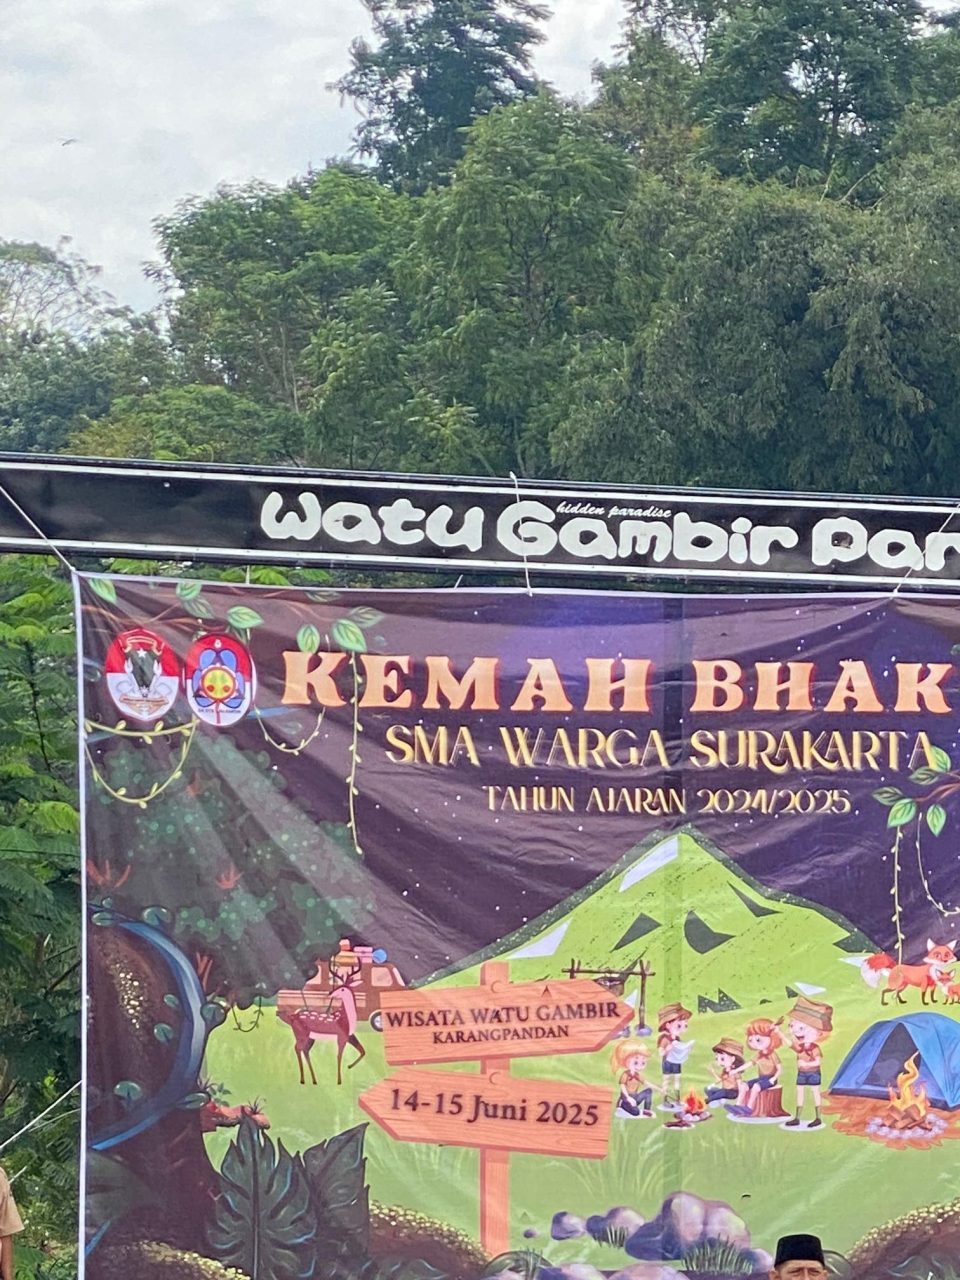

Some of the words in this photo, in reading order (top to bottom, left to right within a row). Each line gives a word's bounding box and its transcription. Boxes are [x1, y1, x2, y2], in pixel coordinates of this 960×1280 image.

[556, 501, 605, 515] hidden
[608, 505, 672, 519] paradise
[261, 491, 485, 552] Watu
[496, 500, 799, 566] Gambir
[281, 650, 653, 713] KEMAH
[384, 724, 482, 768] SMA
[499, 727, 671, 770] WARGA
[689, 729, 940, 774] SURAKARTA
[482, 785, 575, 813] TAHUN
[585, 786, 688, 817] AJARAN
[696, 787, 852, 815] 2024/2025
[386, 1008, 465, 1028] WISATA
[470, 1005, 530, 1024] WATU
[535, 1001, 621, 1021] GAMBIR
[433, 1024, 570, 1045] KARANGPANDAN
[390, 1088, 463, 1116] 14-15
[467, 1094, 527, 1124] Juni
[535, 1100, 599, 1127] 2025
